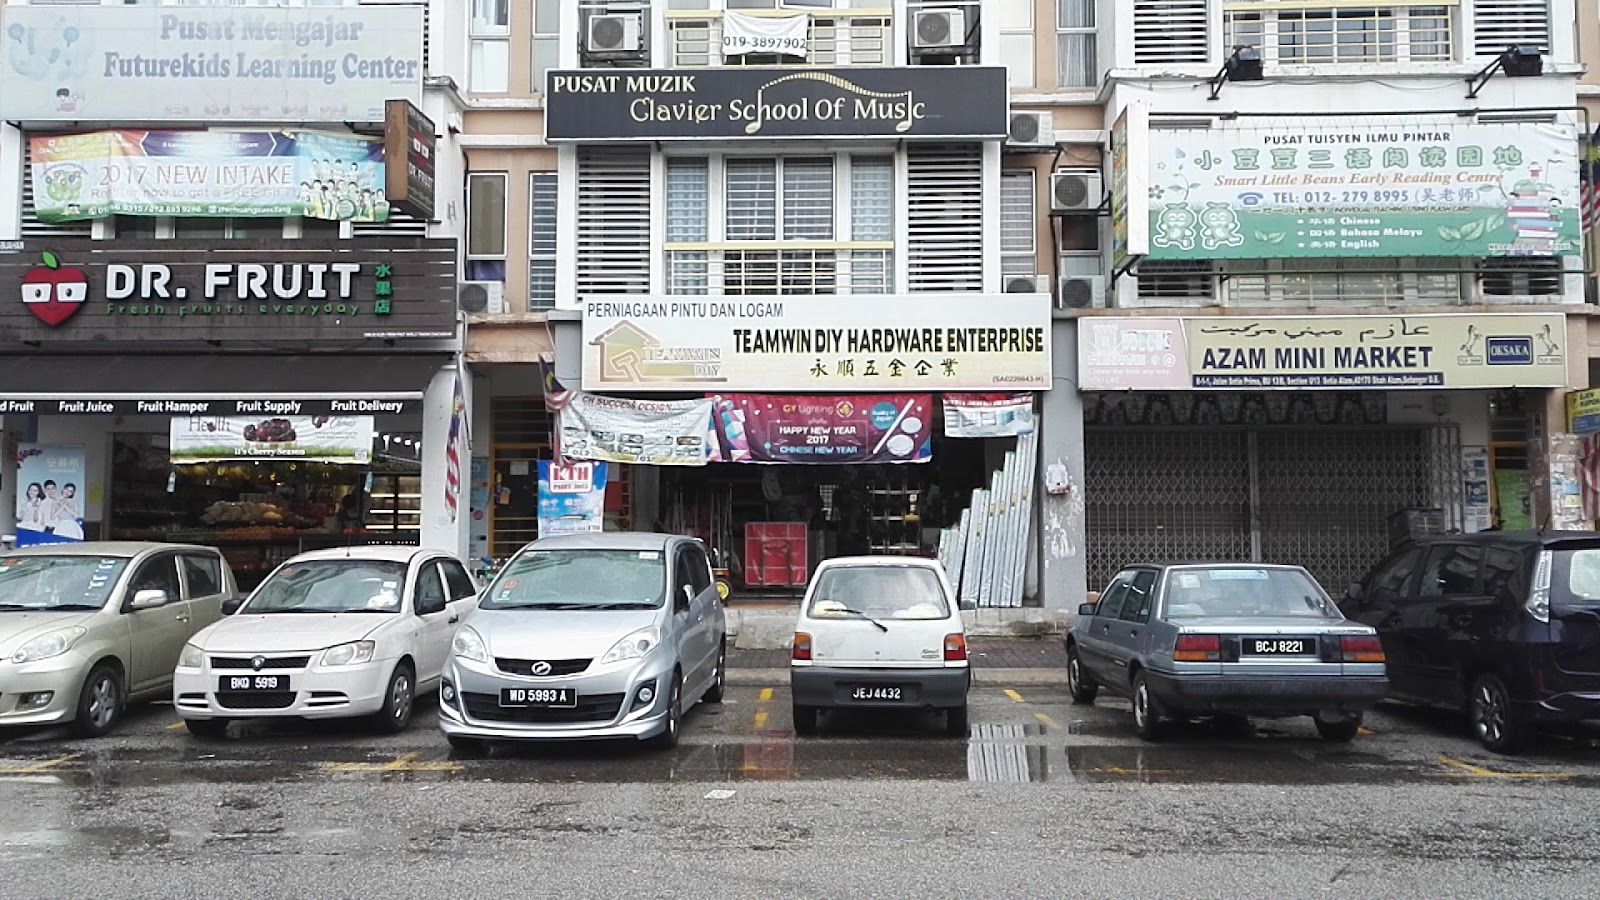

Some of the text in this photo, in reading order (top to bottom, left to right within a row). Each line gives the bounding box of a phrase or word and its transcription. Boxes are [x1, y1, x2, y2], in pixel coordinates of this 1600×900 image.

[160, 14, 363, 47] Pusat Mengajar
[723, 36, 806, 49] 019-3897902
[104, 52, 417, 85] Futurekids Learning Center
[553, 76, 696, 93] PUSAT MUZIK
[630, 90, 926, 134] Clavier School Of Music
[1264, 132, 1451, 144] PUSAT TUISYEN ILMU PINTAR
[100, 164, 147, 186] 2017
[157, 164, 208, 185] NEW
[216, 164, 292, 184] INTAKE
[1214, 171, 1504, 186] Smart Little Beans Early Reading Centre
[1273, 192, 1300, 203] TEL:
[1342, 191, 1367, 202] 279
[1374, 190, 1409, 202] 8995
[1340, 216, 1381, 226] Chinese
[1340, 227, 1380, 237] Bahasa
[1383, 227, 1424, 238] Melayu
[1341, 239, 1380, 250] English
[105, 263, 361, 299] DR. FRUIT
[374, 263, 393, 315] 水果店
[106, 303, 166, 315] Fresh
[259, 300, 360, 316] everyday
[587, 303, 783, 318] PERNIAGAAN PINTU DAN LOGAM
[733, 327, 1044, 353] TEAMWIN DIY HARDWARE ENTERPRISE
[1490, 345, 1529, 356] OKSAKA
[1202, 346, 1433, 370] AZAM MINI MARKET
[694, 363, 721, 377] DIY
[809, 358, 959, 377] 永順五金企業
[9, 401, 35, 411] Fruit
[59, 401, 114, 412] Fruit Juice
[138, 401, 209, 414] Fruit Hamper
[236, 401, 301, 414] Fruit Supply
[331, 400, 403, 413] Fruit Delivery
[638, 402, 673, 411] DESIGN
[799, 403, 834, 415] Lighting
[779, 425, 856, 435] HAPPY NEW YEAR
[806, 435, 829, 444] 2017
[248, 447, 276, 458] Cherry
[277, 448, 305, 456] Season
[779, 446, 812, 454] CHINESE
[815, 446, 834, 454] NEW
[553, 467, 589, 481] KTH
[1255, 640, 1303, 653] BCJ 8221
[255, 676, 278, 689] 5919
[509, 689, 567, 702] WD 5993 A
